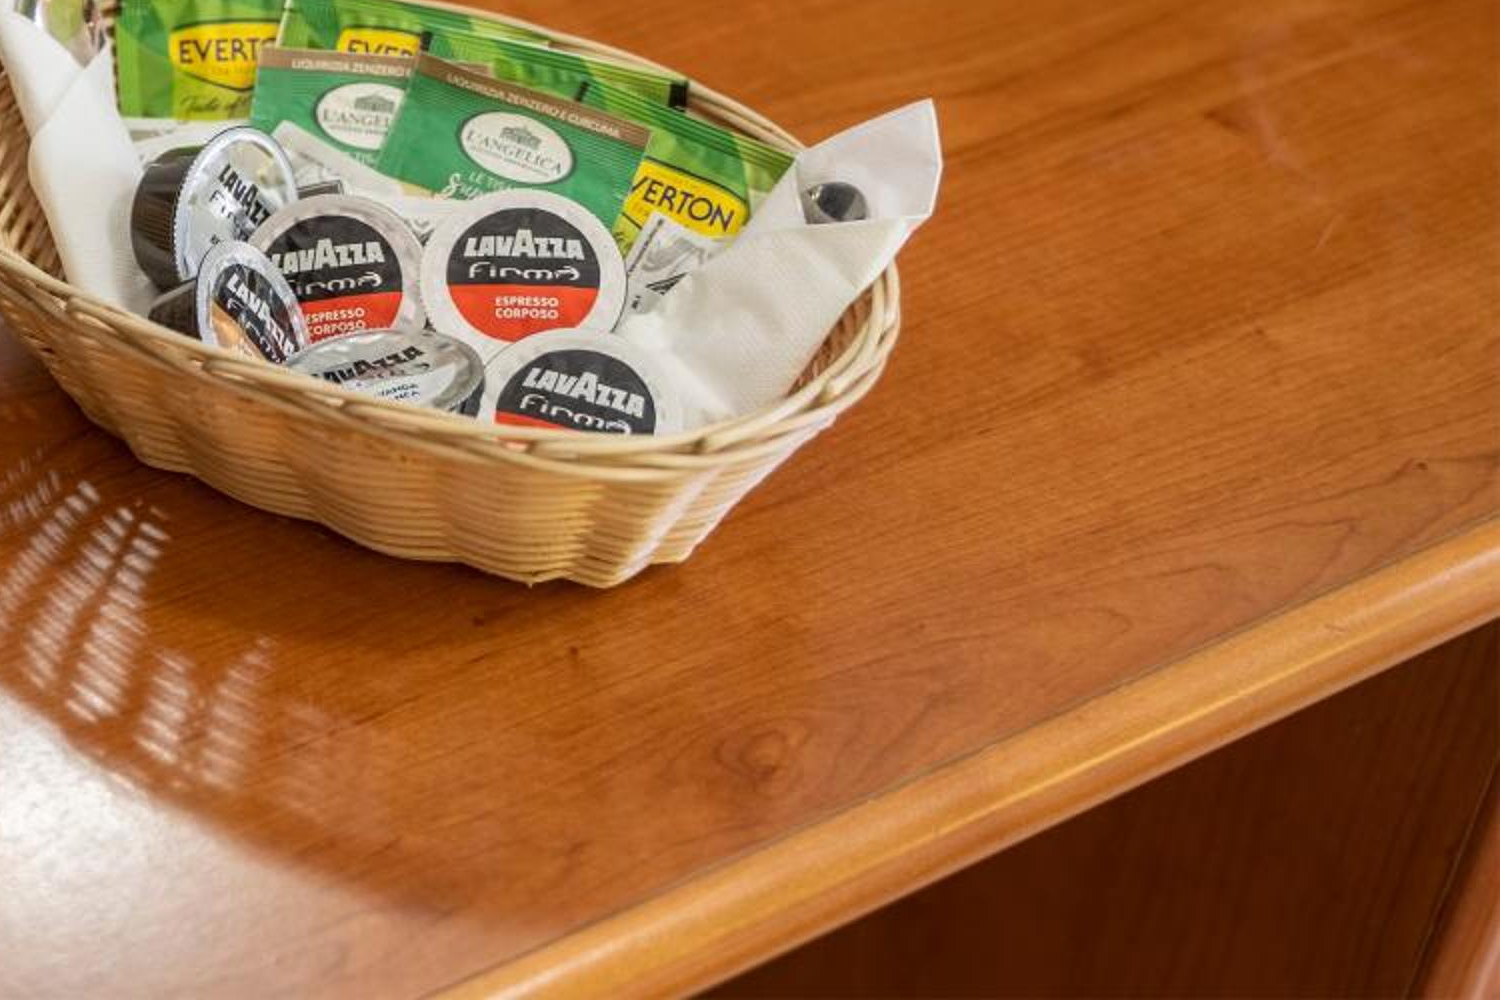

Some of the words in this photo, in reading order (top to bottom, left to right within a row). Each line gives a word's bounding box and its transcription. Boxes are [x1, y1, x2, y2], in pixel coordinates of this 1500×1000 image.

[466, 128, 563, 175] L'ANGELICA
[463, 229, 585, 260] LAVAZZA
[495, 295, 560, 307] ESPRESSO
[495, 307, 560, 320] CORPOSO
[311, 345, 425, 384] AVAZZA
[522, 367, 646, 418] LAVAZZA
